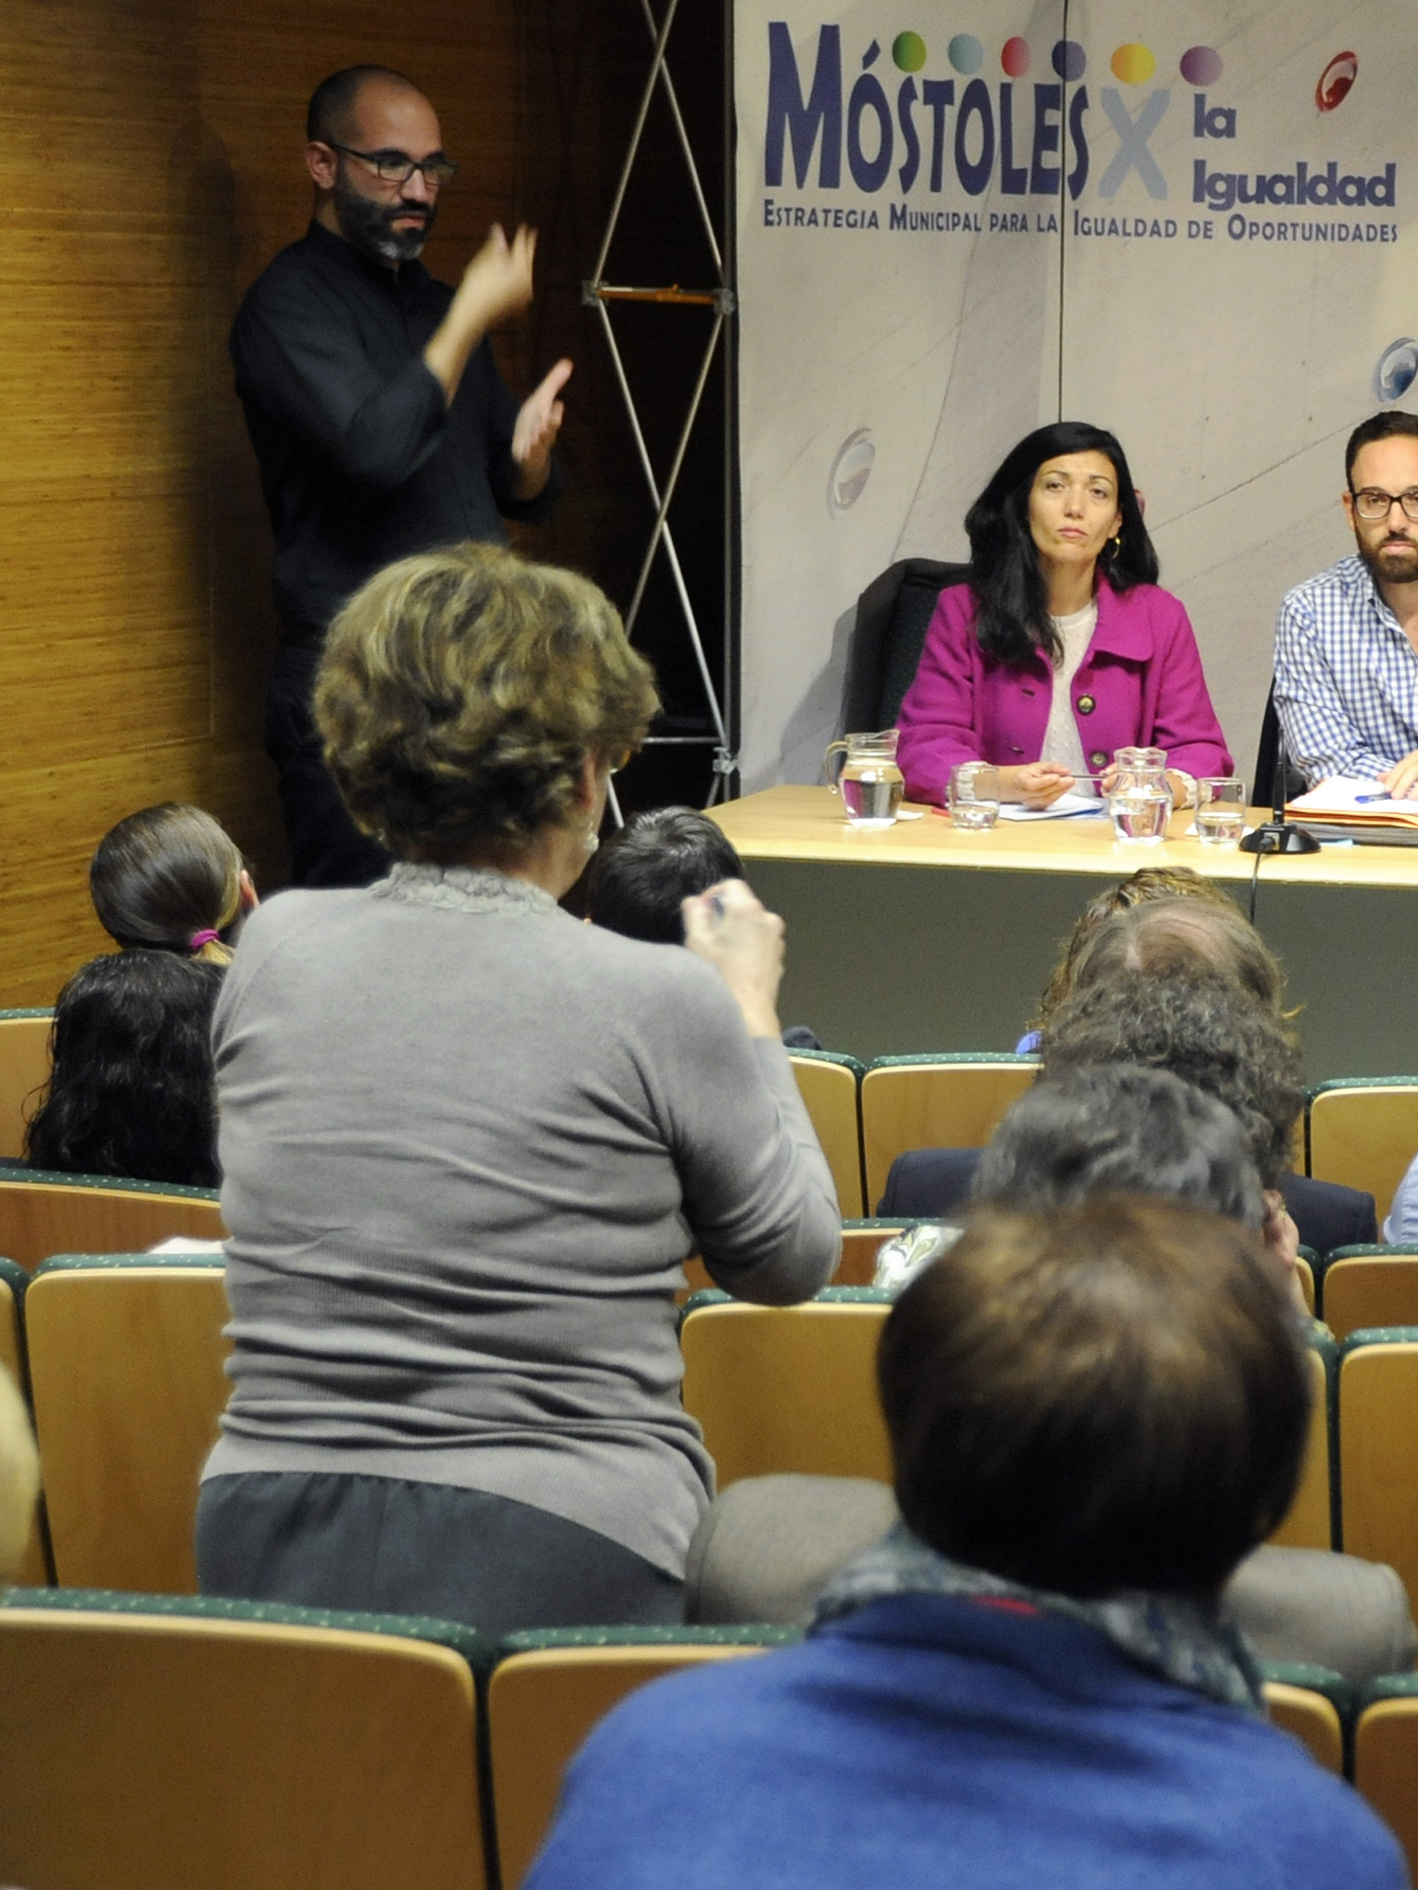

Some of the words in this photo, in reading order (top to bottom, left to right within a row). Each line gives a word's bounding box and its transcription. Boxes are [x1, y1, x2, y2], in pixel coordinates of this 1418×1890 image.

[764, 20, 1089, 201] MÓSTOLES
[1099, 86, 1171, 200] X
[1192, 93, 1236, 139] la
[1192, 160, 1397, 210] Igualdad
[763, 199, 880, 230] ESTRATEGIA
[888, 203, 982, 233] MUNICIPAL
[989, 211, 1029, 234] PARA
[1037, 212, 1059, 234] LA
[1072, 209, 1178, 239] IGUALDAD
[1186, 215, 1213, 240] DE
[1226, 213, 1398, 243] OPORTUNIDADES
